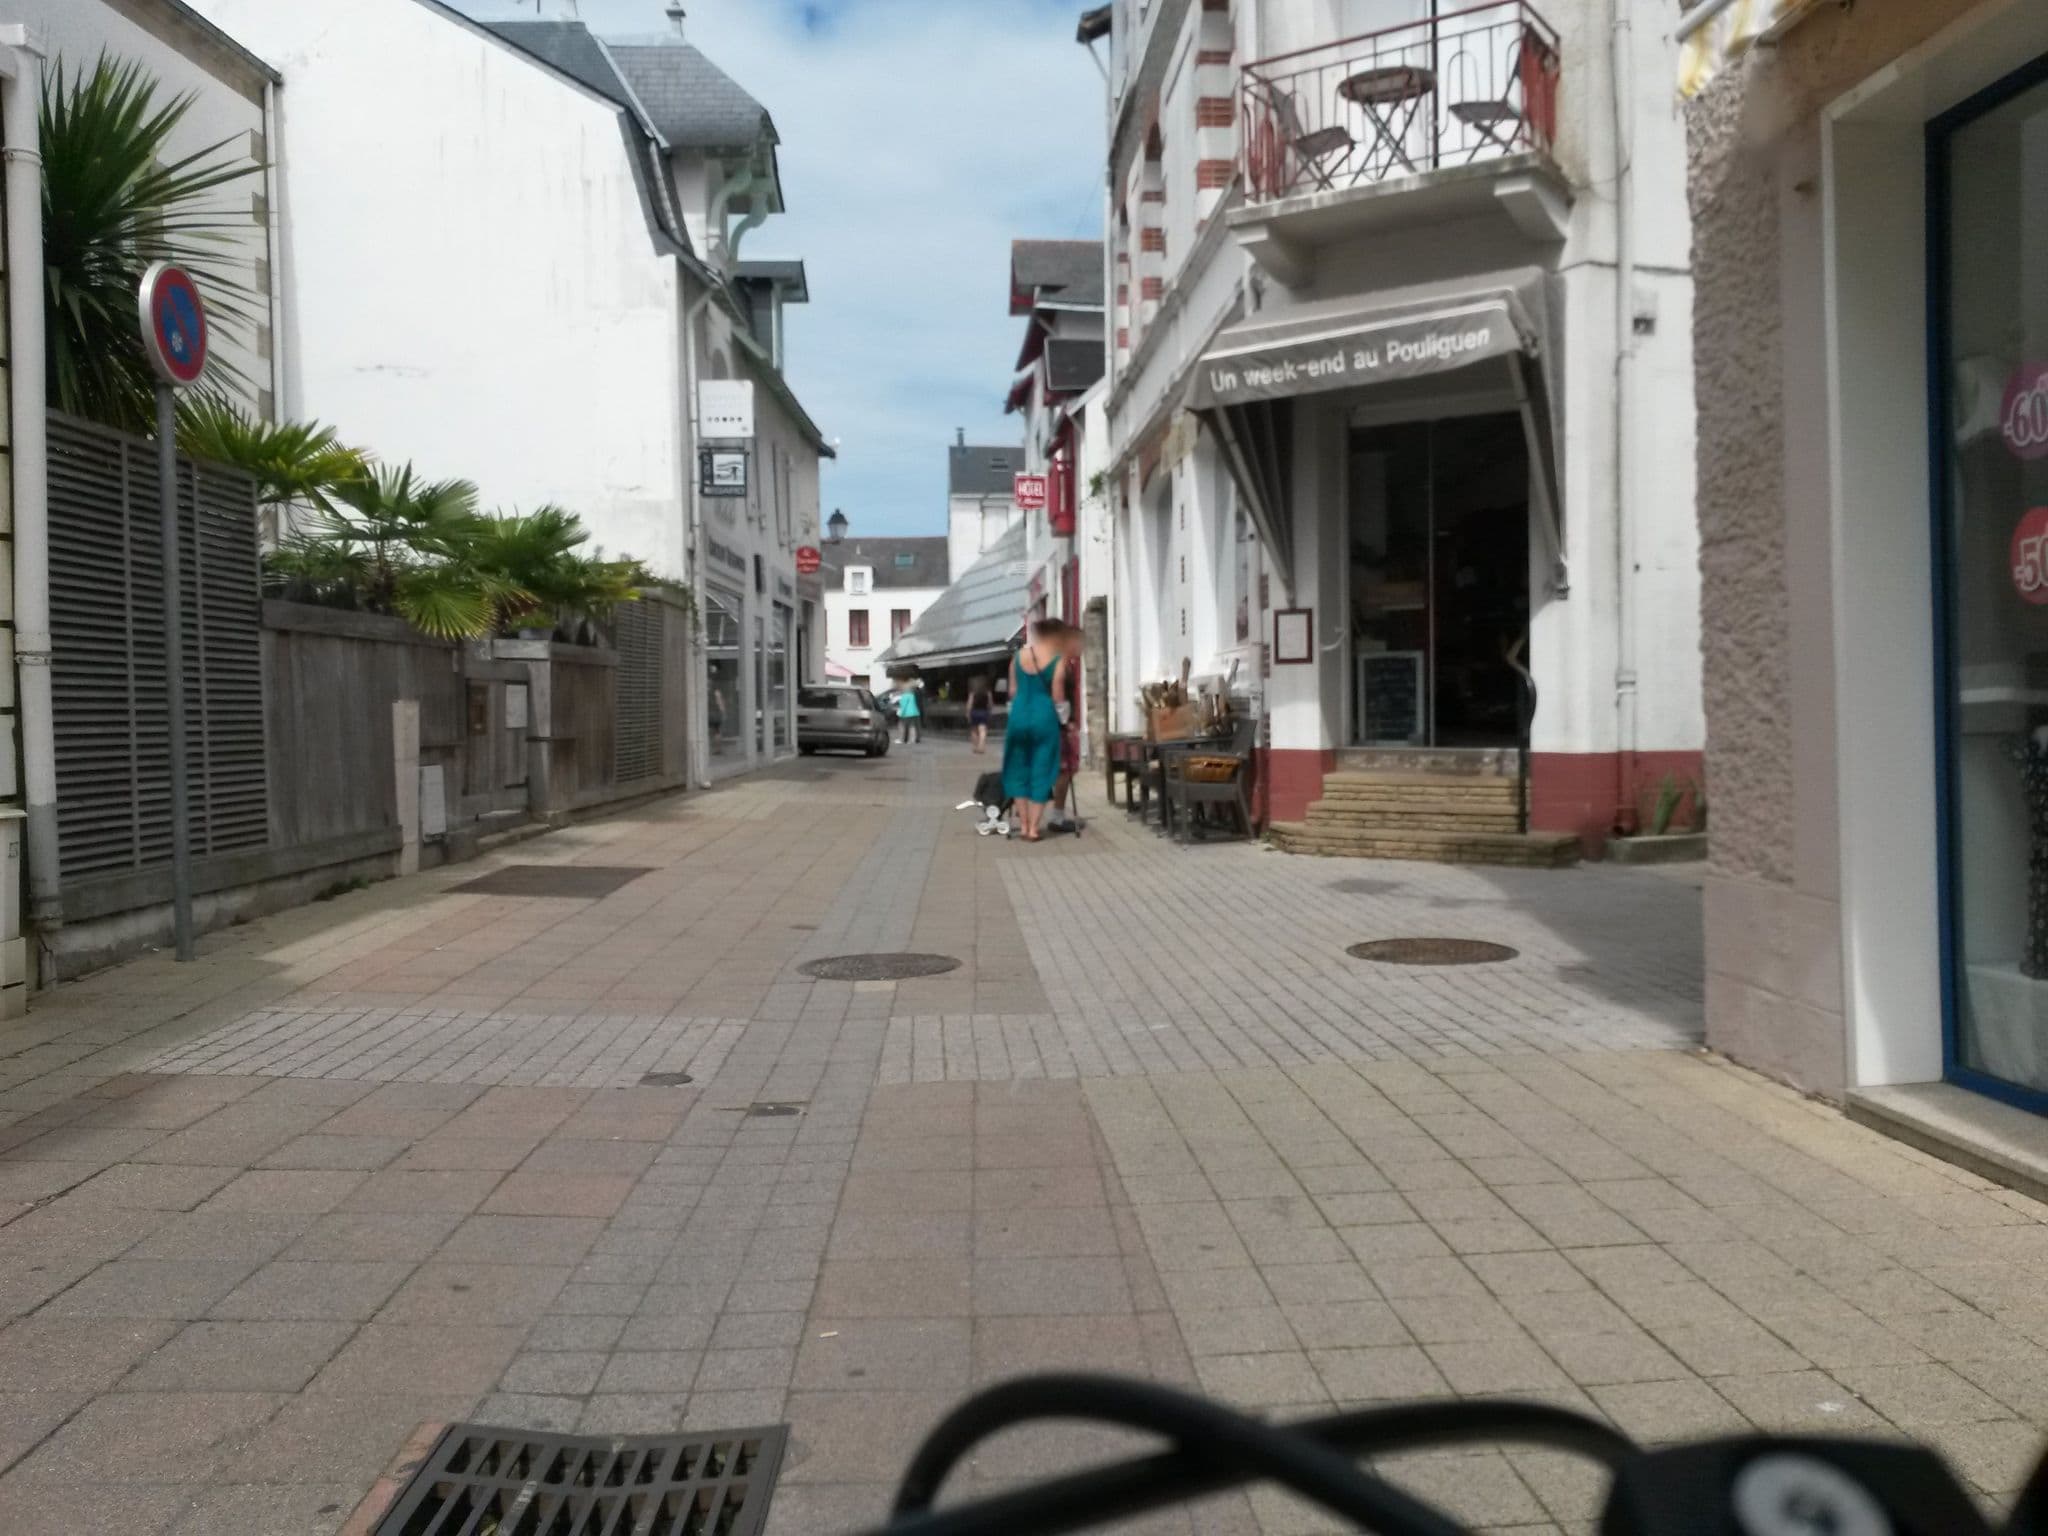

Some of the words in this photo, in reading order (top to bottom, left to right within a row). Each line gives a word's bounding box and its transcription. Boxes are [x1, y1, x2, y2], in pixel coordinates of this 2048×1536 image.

[1210, 370, 1238, 393] Un
[1244, 350, 1346, 388] week-end
[1353, 349, 1379, 370] au
[1386, 327, 1491, 364] Pouliguen
